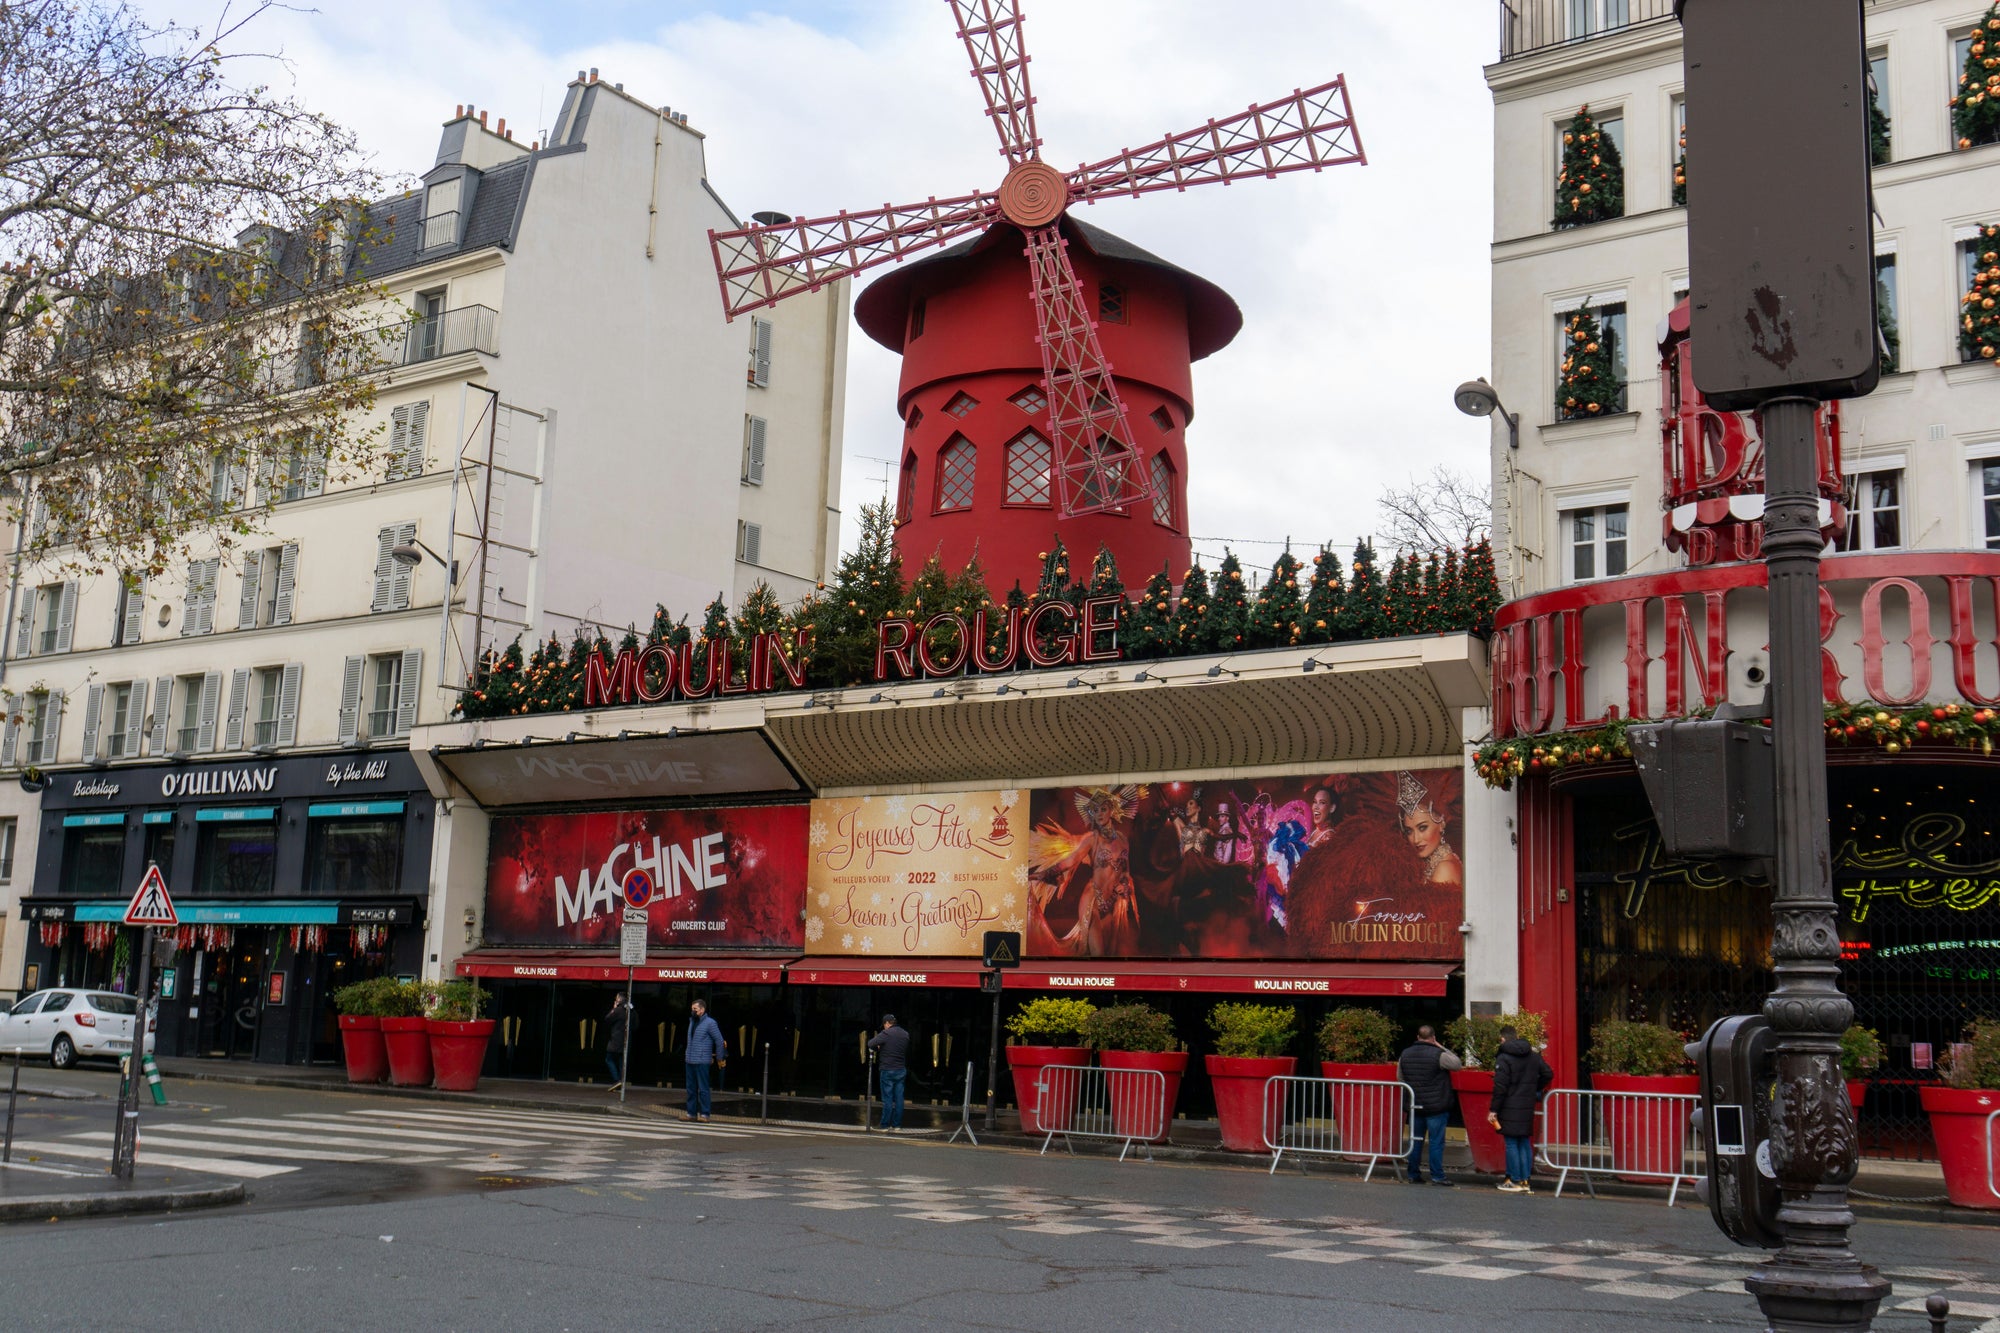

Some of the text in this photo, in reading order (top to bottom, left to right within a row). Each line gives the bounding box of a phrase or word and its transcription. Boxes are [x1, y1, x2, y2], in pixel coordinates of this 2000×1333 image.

[585, 593, 1124, 707] MOULIN ROUGE
[326, 759, 388, 788] By the Mill
[73, 779, 119, 800] Backstage
[161, 767, 278, 797] O'SULLIVANS
[817, 804, 995, 870] Joyeuses Fêtes
[554, 831, 728, 928] MACHINE
[833, 875, 890, 884] MEILLEURS VOEUX
[908, 872, 936, 884] 2022
[954, 872, 998, 881] BEST WISHES
[829, 885, 1000, 951] Season's Greetings!
[1347, 897, 1426, 930] Forever
[672, 921, 726, 931] CONCERTS CLUB
[1330, 922, 1448, 944] MOULIN ROUGE
[514, 966, 557, 977] MOULIN ROUGE
[658, 970, 708, 979] MOULIN ROUGE
[869, 974, 927, 983] MOULIN ROUGE
[1049, 976, 1115, 987] MOULIN ROUGE
[1254, 980, 1329, 991] MOULIN ROUGE
